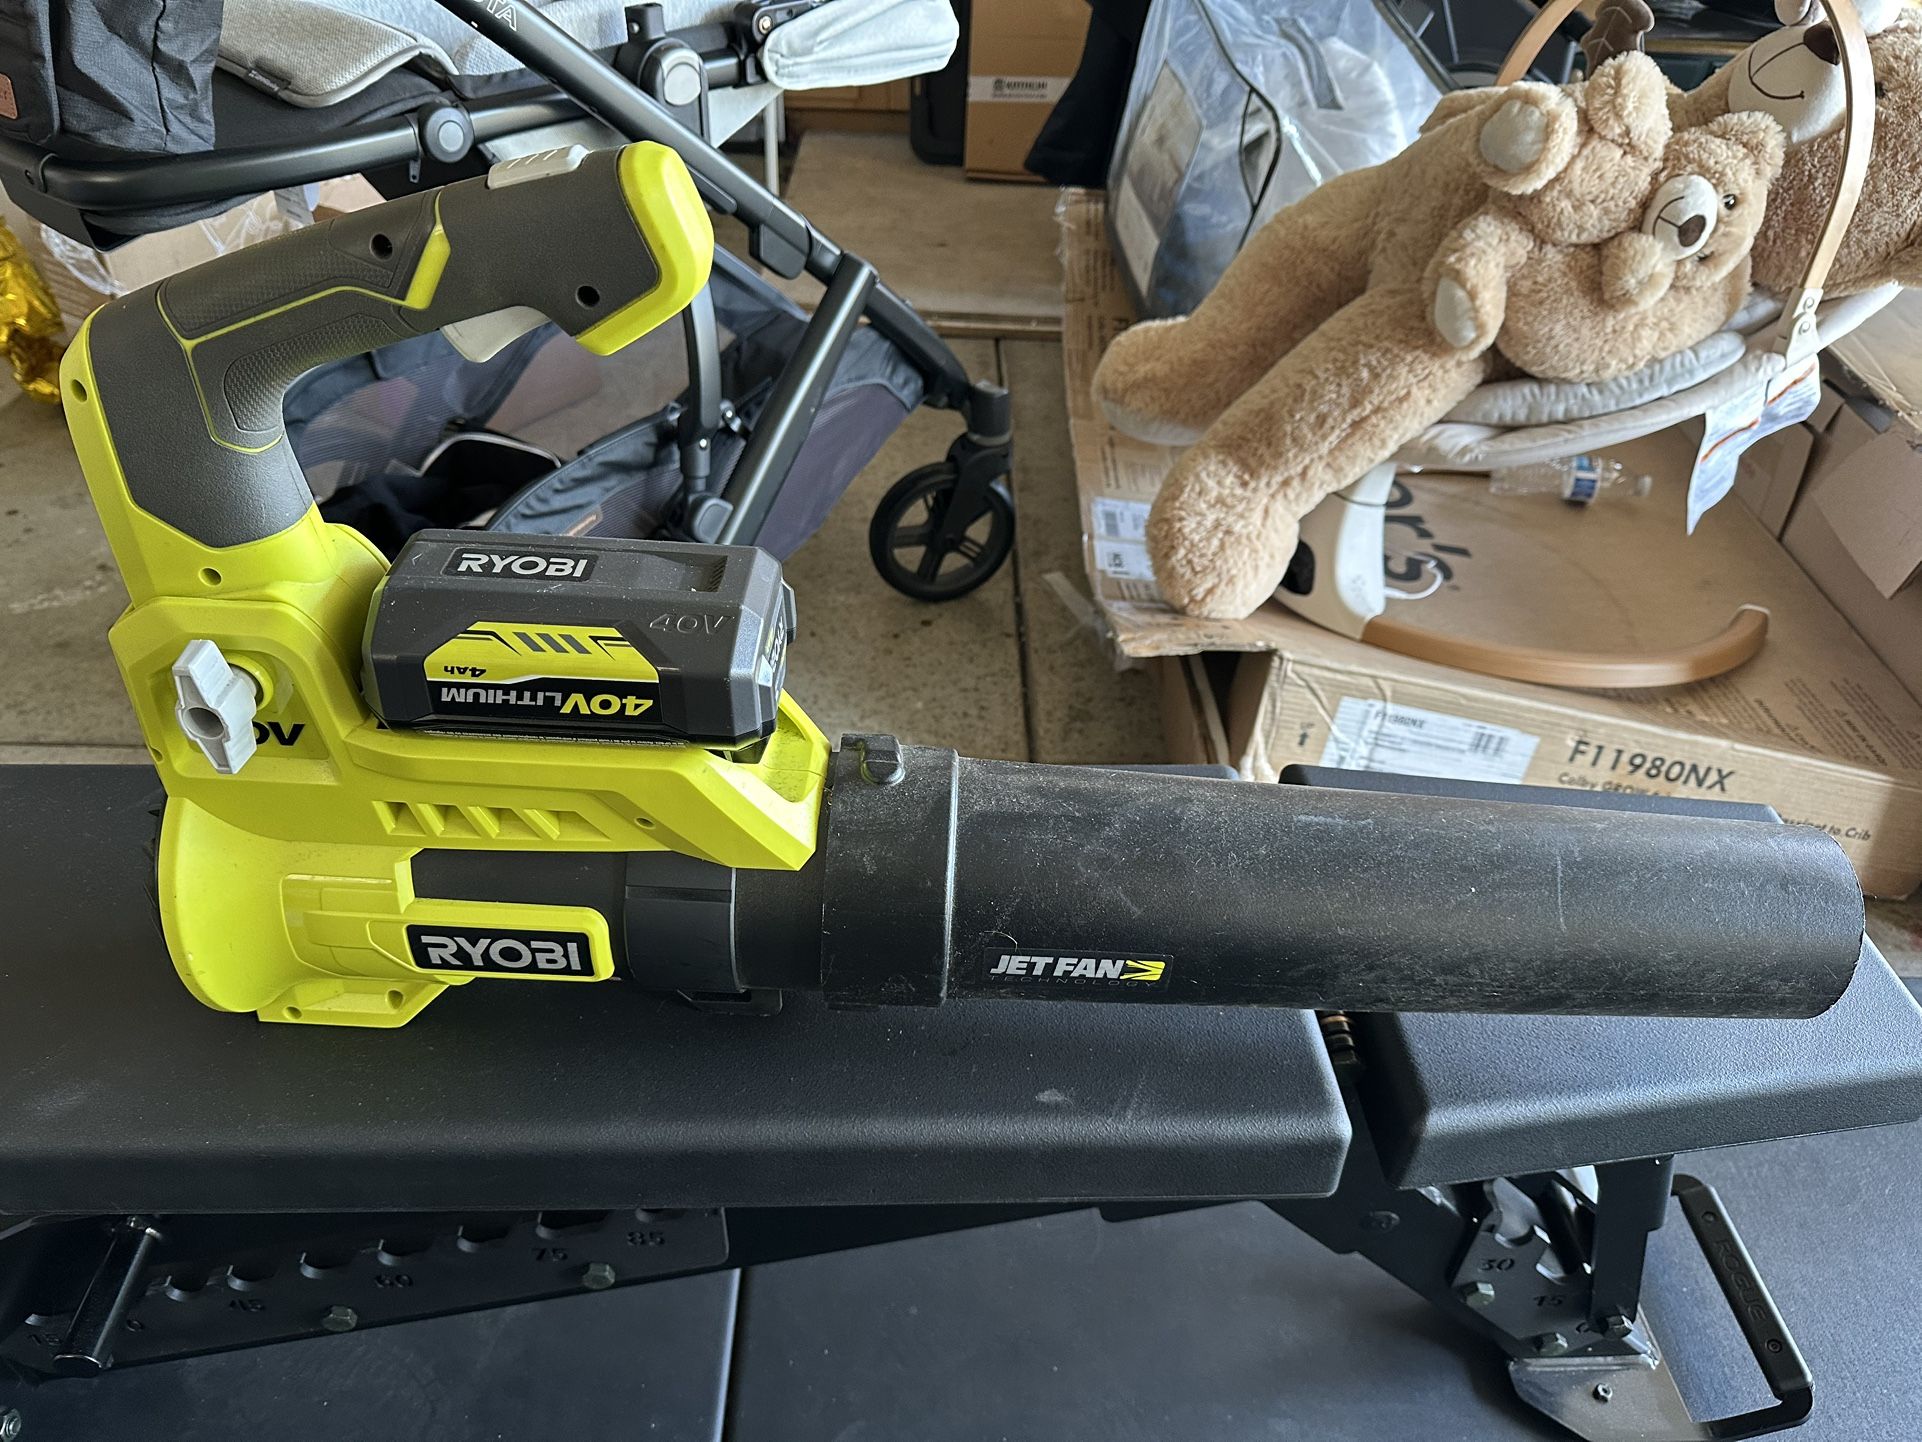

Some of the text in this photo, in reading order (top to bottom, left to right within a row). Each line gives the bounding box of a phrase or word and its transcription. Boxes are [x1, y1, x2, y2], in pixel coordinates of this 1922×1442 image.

[457, 553, 588, 578] RYOBI
[649, 613, 735, 635] 40V
[443, 665, 487, 678] 4Ah
[441, 687, 653, 716] 40V LITHIUM
[1568, 739, 1735, 793] F11980NX
[1845, 827, 1871, 841] Crib
[420, 935, 582, 971] RYOBI
[990, 954, 1125, 979] JET FAN
[991, 975, 1157, 988] TECHNOLOGY
[532, 1247, 569, 1263] 75
[1713, 1239, 1768, 1322] ROGUE
